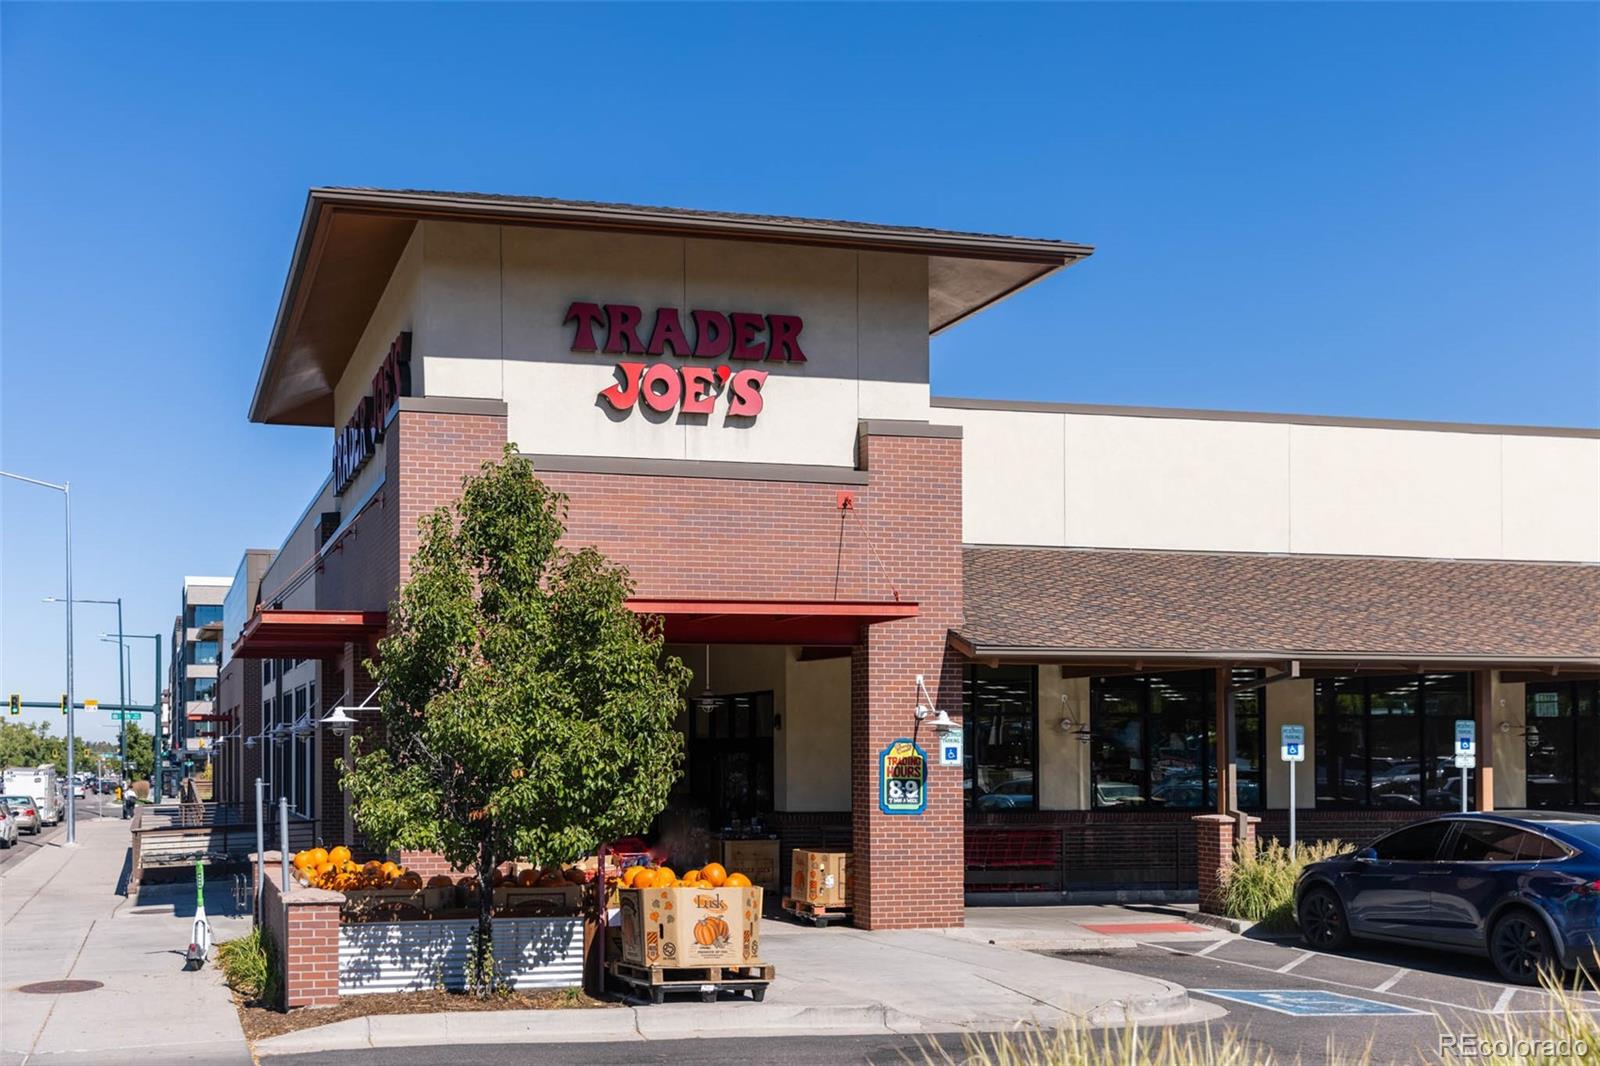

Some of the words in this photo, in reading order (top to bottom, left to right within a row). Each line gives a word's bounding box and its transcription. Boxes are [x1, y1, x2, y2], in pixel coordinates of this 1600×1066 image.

[562, 302, 807, 363] TRADER
[600, 362, 768, 416] JOE'S
[887, 756, 921, 766] TRADING
[887, 766, 921, 778] HOURS
